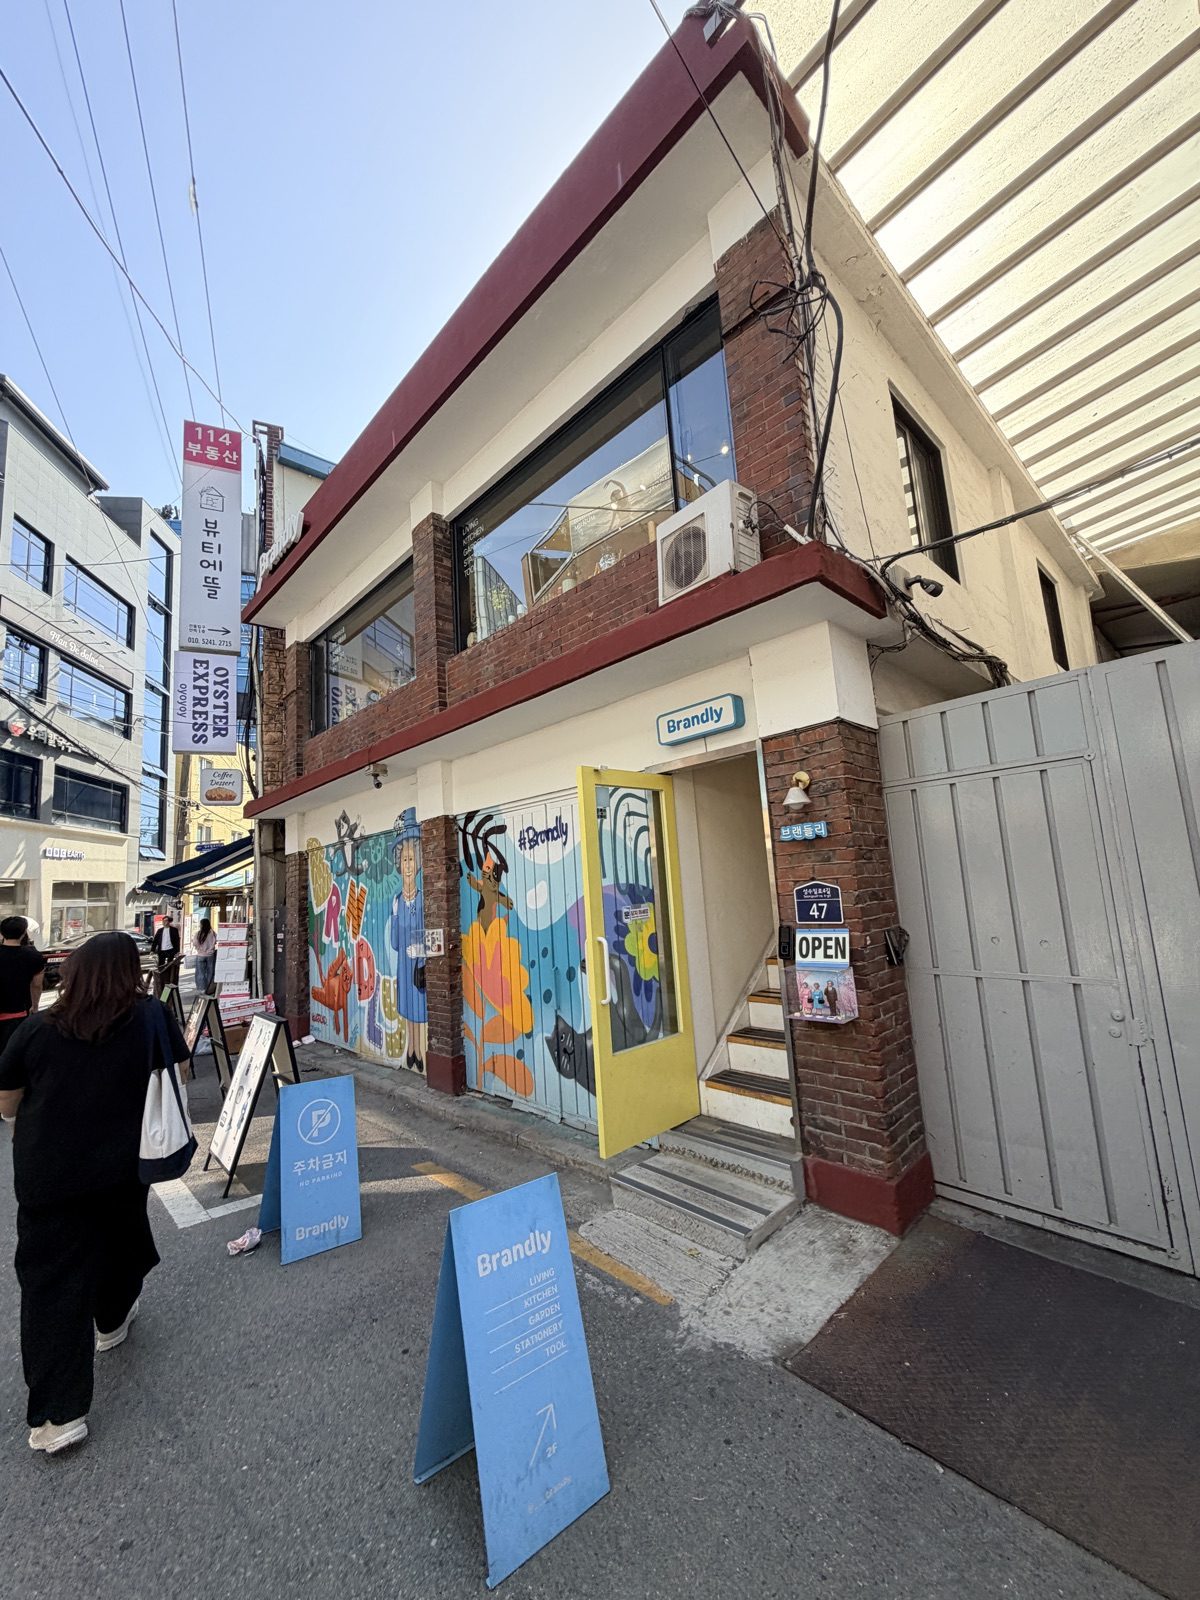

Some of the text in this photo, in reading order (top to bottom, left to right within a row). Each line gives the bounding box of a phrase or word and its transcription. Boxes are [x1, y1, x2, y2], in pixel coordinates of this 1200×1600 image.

[195, 426, 232, 446] 114
[186, 441, 239, 465] 부동산
[200, 518, 223, 600] 뷰티에뜰
[177, 683, 187, 718] oyoyoy
[192, 658, 209, 744] EXPRESS
[213, 666, 230, 738] OYSTER
[667, 706, 723, 734] Brandly
[210, 779, 235, 787] Dessert
[212, 771, 233, 780] Coffee
[518, 815, 568, 851] #Brandly
[781, 821, 827, 840] 브랜들리
[809, 902, 828, 919] 47
[798, 936, 847, 960] OPEN
[293, 1149, 348, 1177] 주차금지
[299, 1170, 343, 1188] NO PARKING
[295, 1214, 349, 1241] Brandly
[476, 1230, 552, 1278] Brandly
[529, 1267, 555, 1287] LIVING
[523, 1285, 558, 1309] KITCHEN
[528, 1302, 561, 1326] GARDEN
[514, 1319, 564, 1354] STATIONERY
[545, 1339, 567, 1357] TOOL
[545, 1441, 558, 1458] 2F
